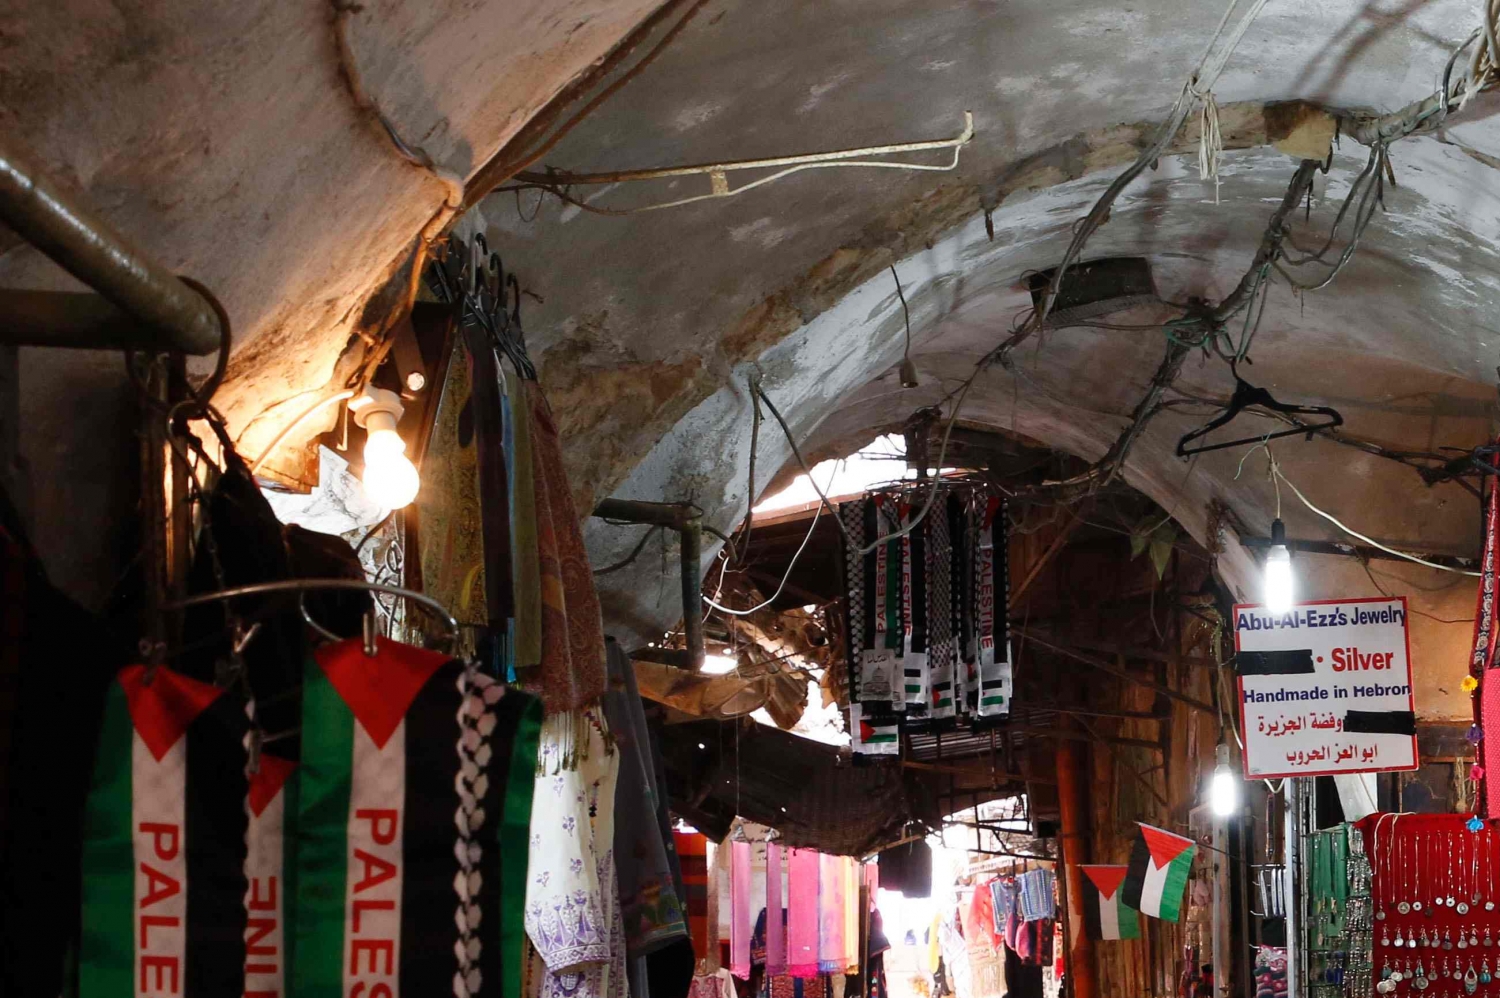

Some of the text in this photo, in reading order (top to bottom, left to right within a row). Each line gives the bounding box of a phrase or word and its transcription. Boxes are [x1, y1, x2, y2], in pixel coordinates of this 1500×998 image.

[981, 548, 994, 650] PALESTINE
[1350, 605, 1407, 627] Jewelry
[1331, 647, 1394, 672] Silver
[1243, 683, 1411, 704] Handmade in Hebron
[1258, 714, 1307, 737] الجزيرة
